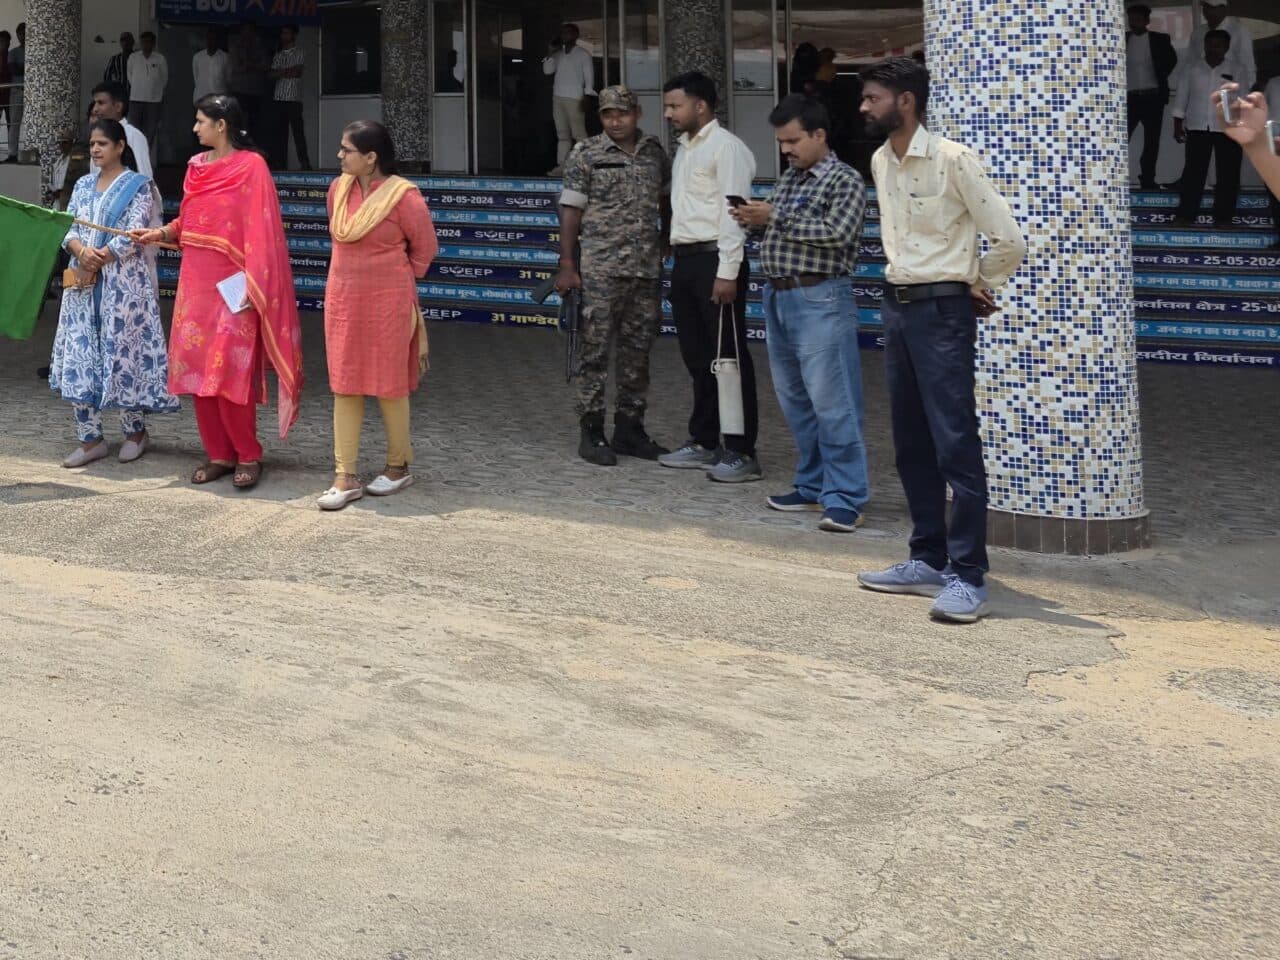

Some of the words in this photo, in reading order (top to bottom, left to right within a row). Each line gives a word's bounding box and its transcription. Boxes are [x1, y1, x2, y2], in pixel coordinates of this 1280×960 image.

[441, 195, 493, 204] 20-05-2024
[505, 197, 551, 207] SWEEP
[474, 231, 525, 240] SWEEP
[1203, 255, 1280, 267] 25-05-2024
[439, 266, 494, 278] SWEEP
[518, 270, 532, 279] 31
[421, 309, 462, 319] EEP
[491, 312, 505, 322] 31
[1135, 350, 1188, 361] सदीय
[1193, 351, 1274, 365] निर्वाचन
